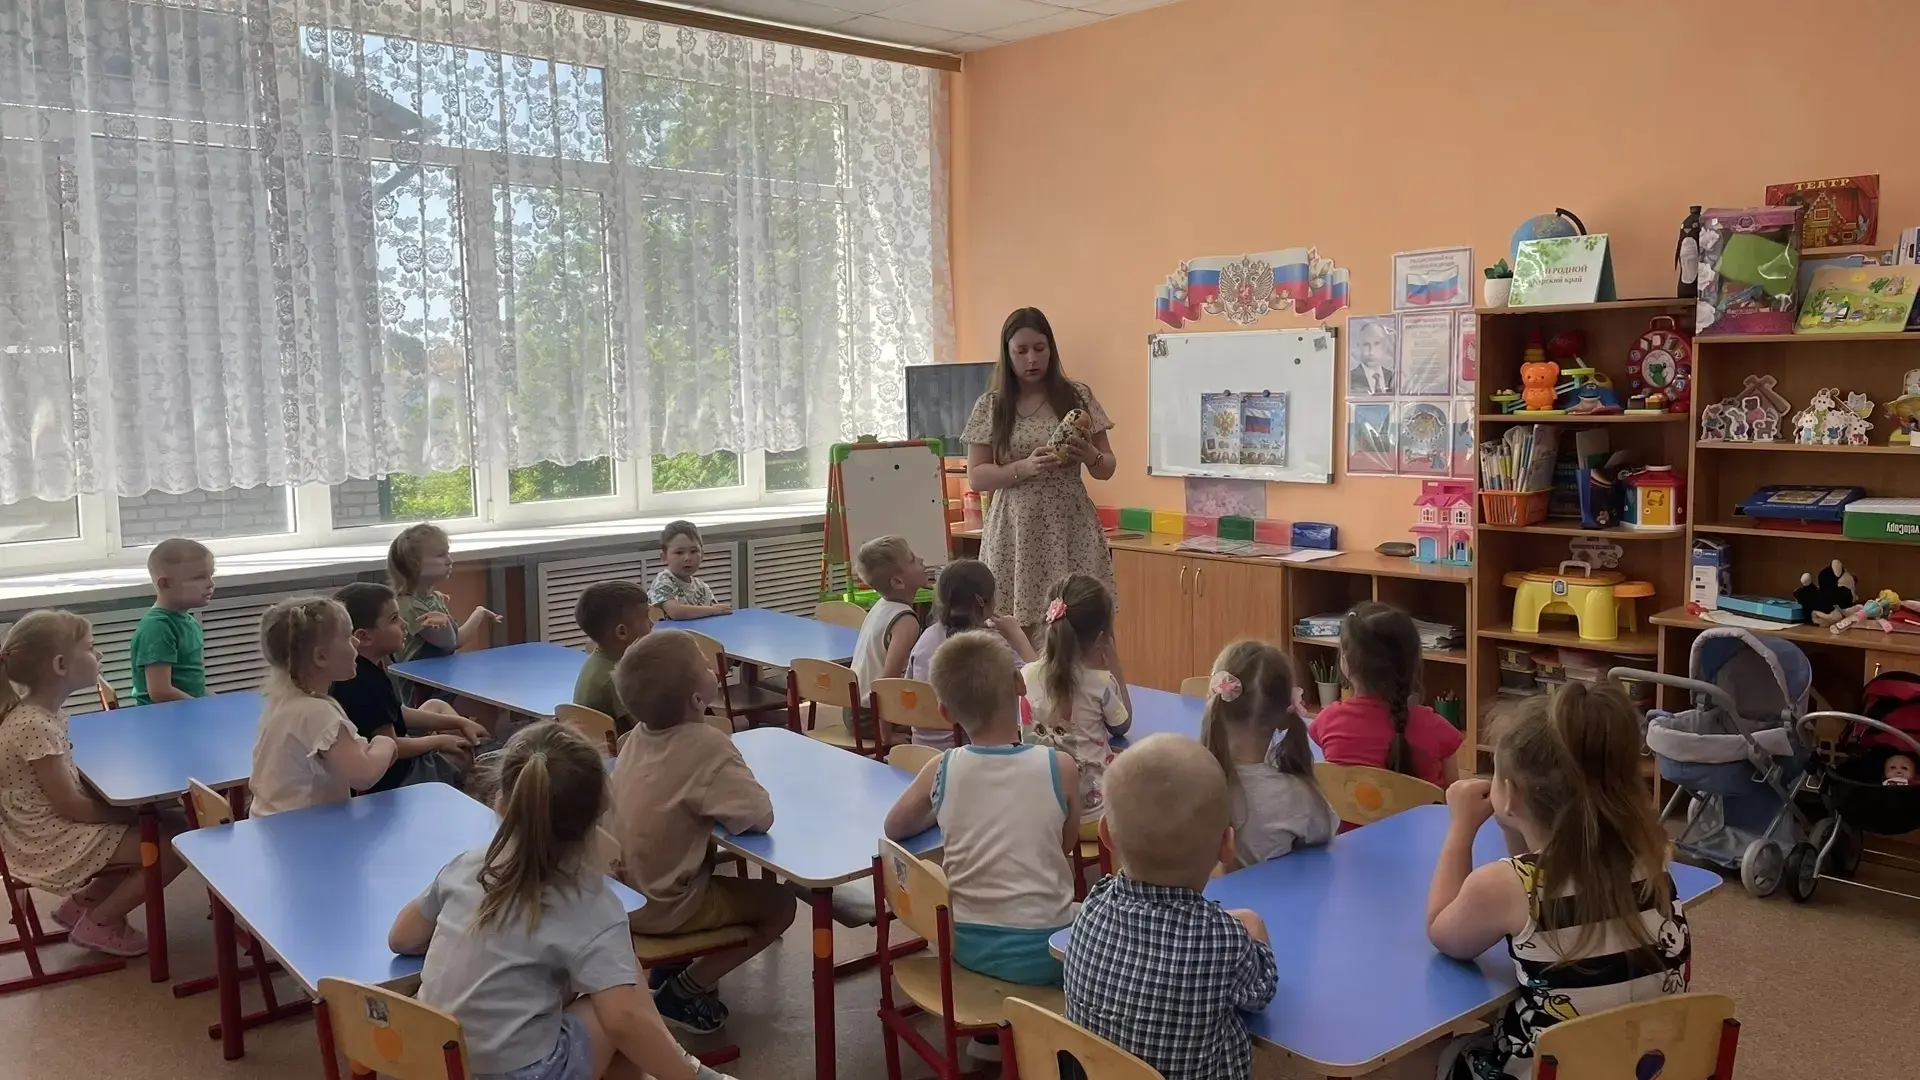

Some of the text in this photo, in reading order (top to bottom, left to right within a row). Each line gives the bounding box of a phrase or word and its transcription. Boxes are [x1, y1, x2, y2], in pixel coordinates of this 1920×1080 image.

[1794, 178, 1850, 191] ТЕАТР
[1552, 264, 1588, 275] РОДНОЙ
[1564, 275, 1583, 285] край
